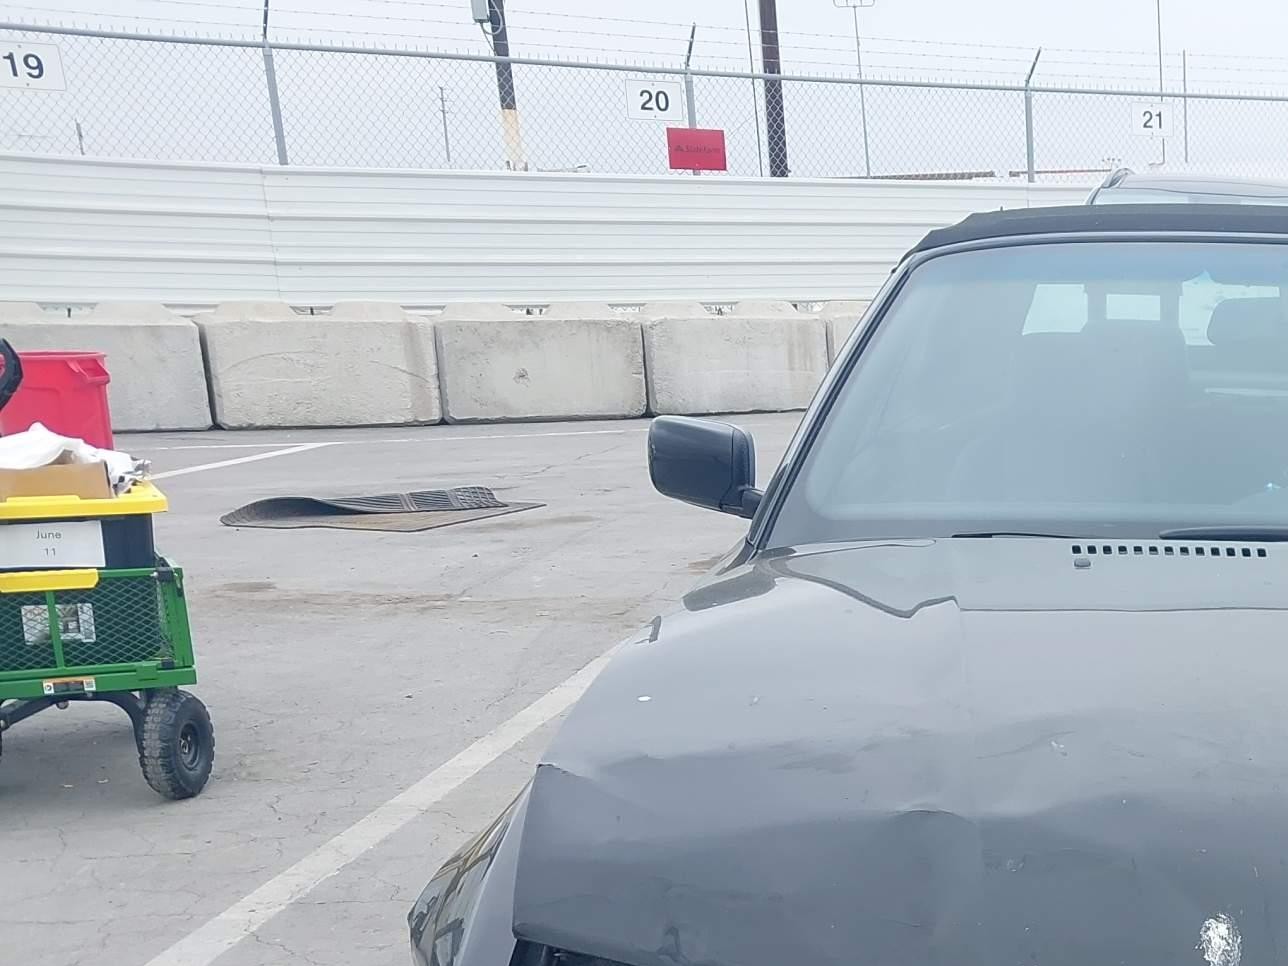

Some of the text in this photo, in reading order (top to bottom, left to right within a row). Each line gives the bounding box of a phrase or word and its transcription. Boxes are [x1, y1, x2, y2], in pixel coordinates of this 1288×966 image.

[2, 51, 44, 79] 19
[639, 89, 670, 112] 20
[1142, 110, 1162, 129] 21
[36, 528, 62, 540] June
[44, 547, 56, 556] 11
